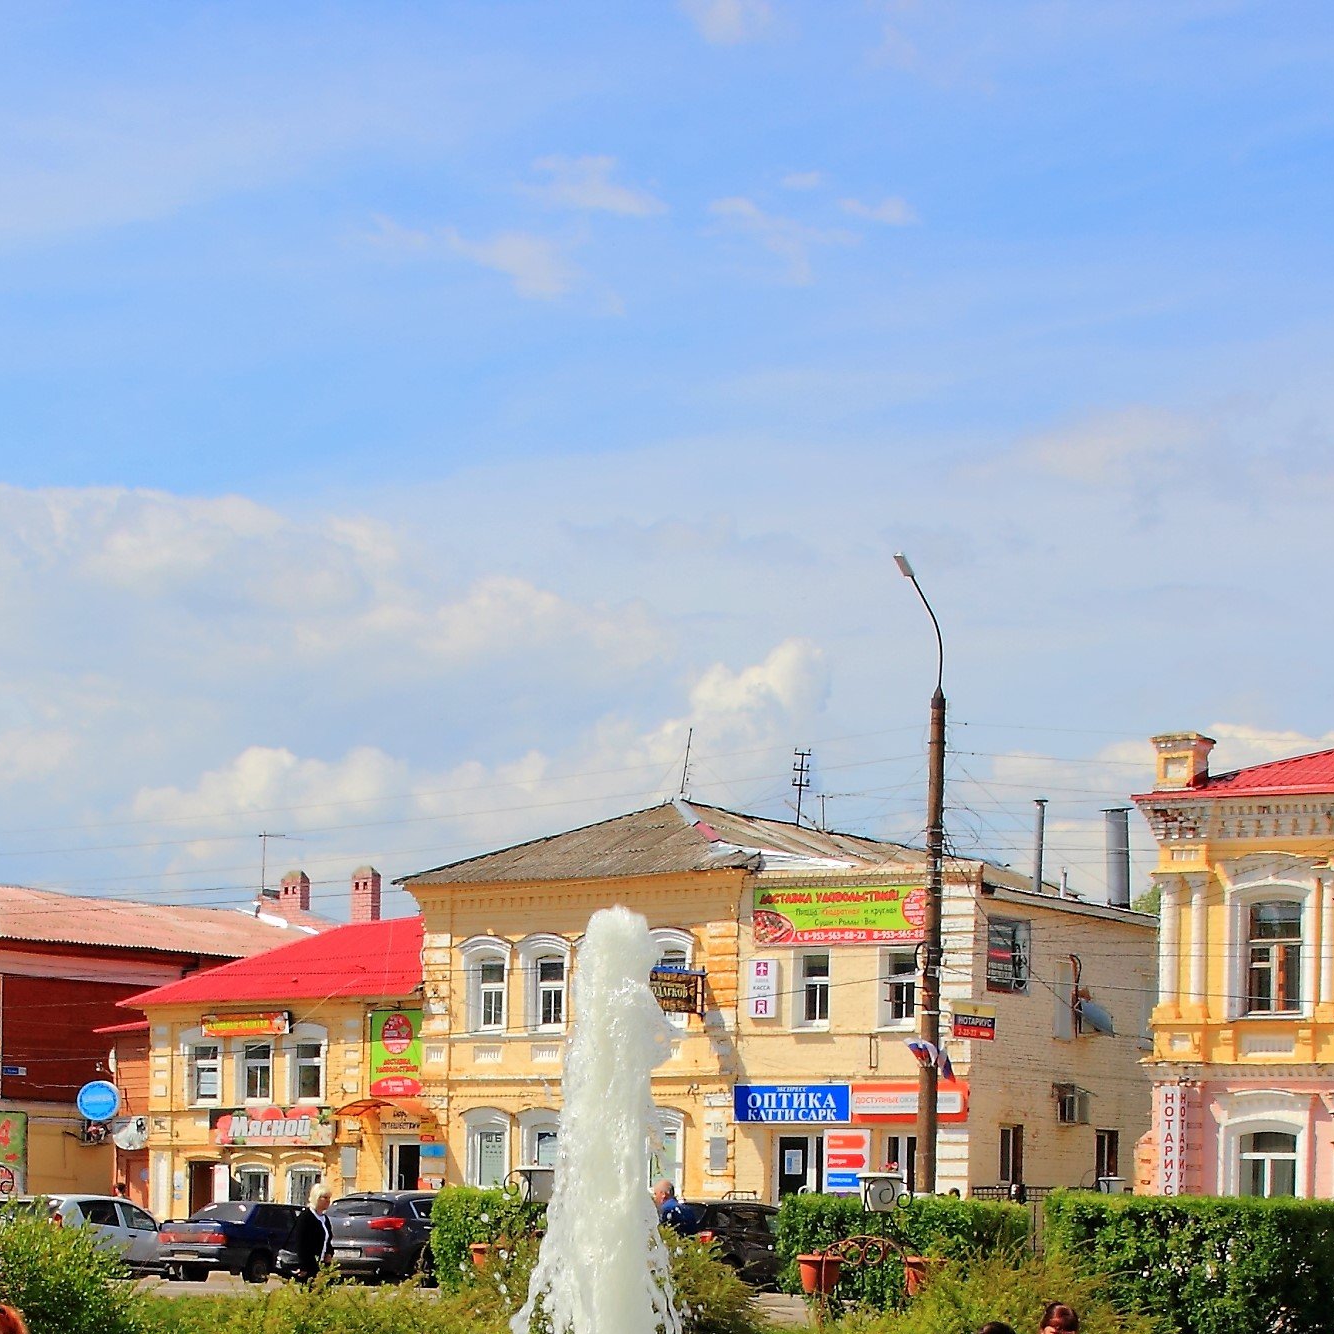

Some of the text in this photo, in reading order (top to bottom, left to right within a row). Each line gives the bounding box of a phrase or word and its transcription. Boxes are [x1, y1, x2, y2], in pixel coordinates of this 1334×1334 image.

[759, 891, 812, 904] ДОСТАВКА
[651, 985, 688, 998] ОДАРКОВ
[958, 1016, 992, 1028] НОТАРИУС
[747, 1092, 837, 1109] ОПТИКА
[855, 1096, 899, 1105] ДОСТУПНЫЕ
[748, 1108, 837, 1121] КАТТИ САРК
[713, 1121, 723, 1133] 175
[1164, 1093, 1174, 1196] НОТАРИУС
